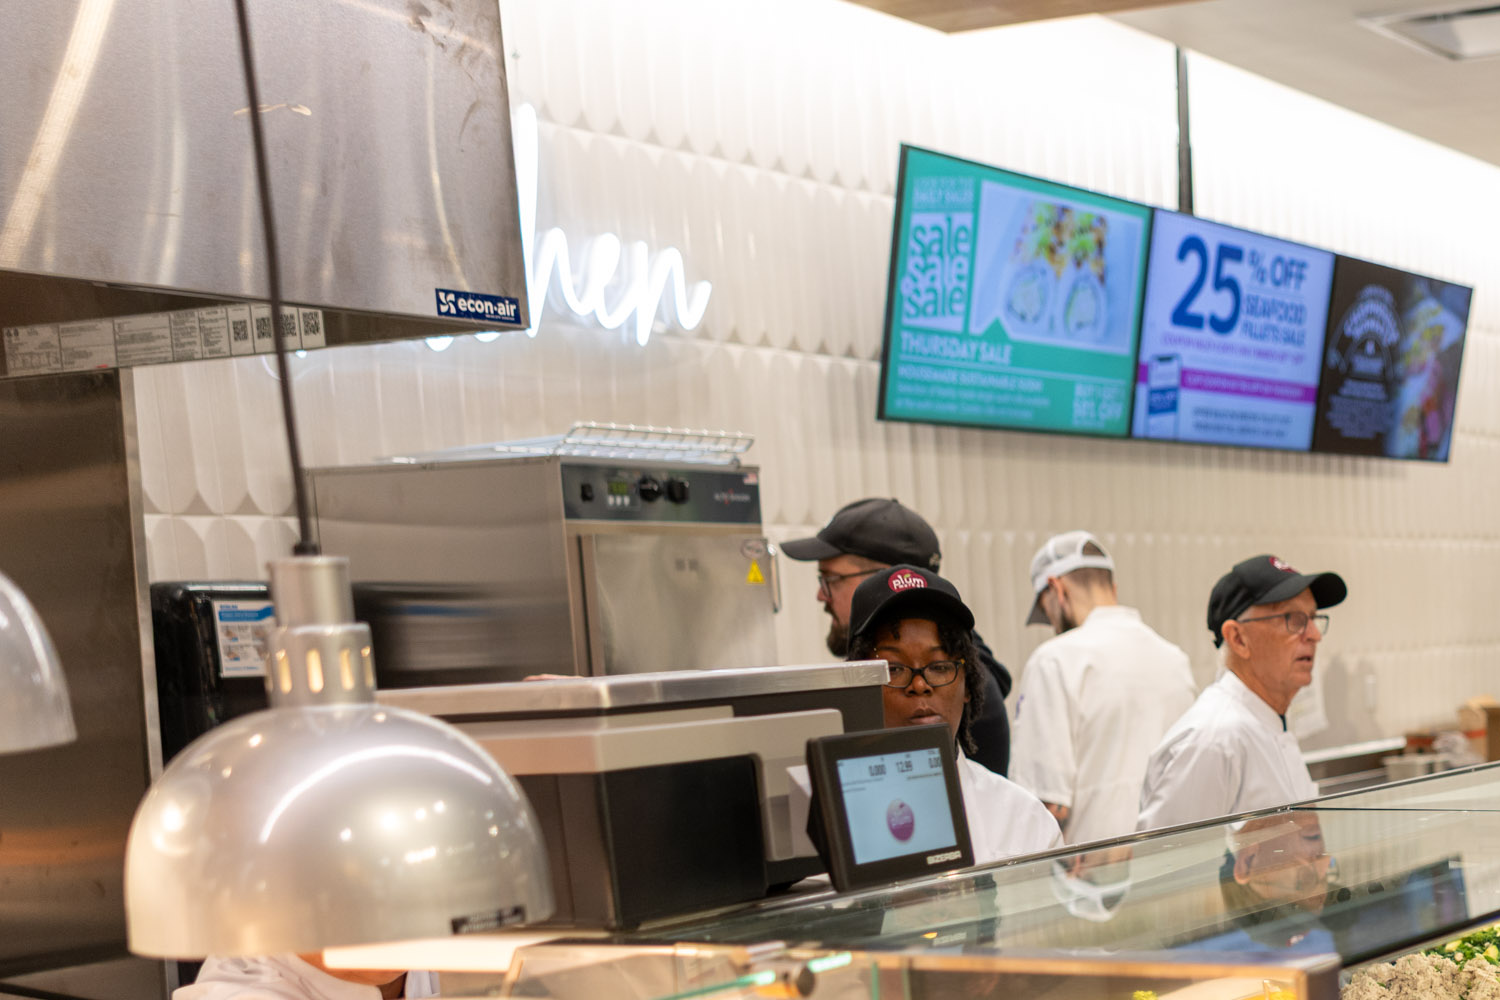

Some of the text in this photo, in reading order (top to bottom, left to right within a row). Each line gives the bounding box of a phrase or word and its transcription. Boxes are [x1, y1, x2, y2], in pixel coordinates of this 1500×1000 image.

[912, 216, 970, 255] sale
[904, 284, 965, 319] sale
[1171, 234, 1243, 335] 25
[1270, 255, 1309, 290] OFF
[901, 331, 1013, 366] THURSDAY SALE
[892, 574, 925, 590] plum
